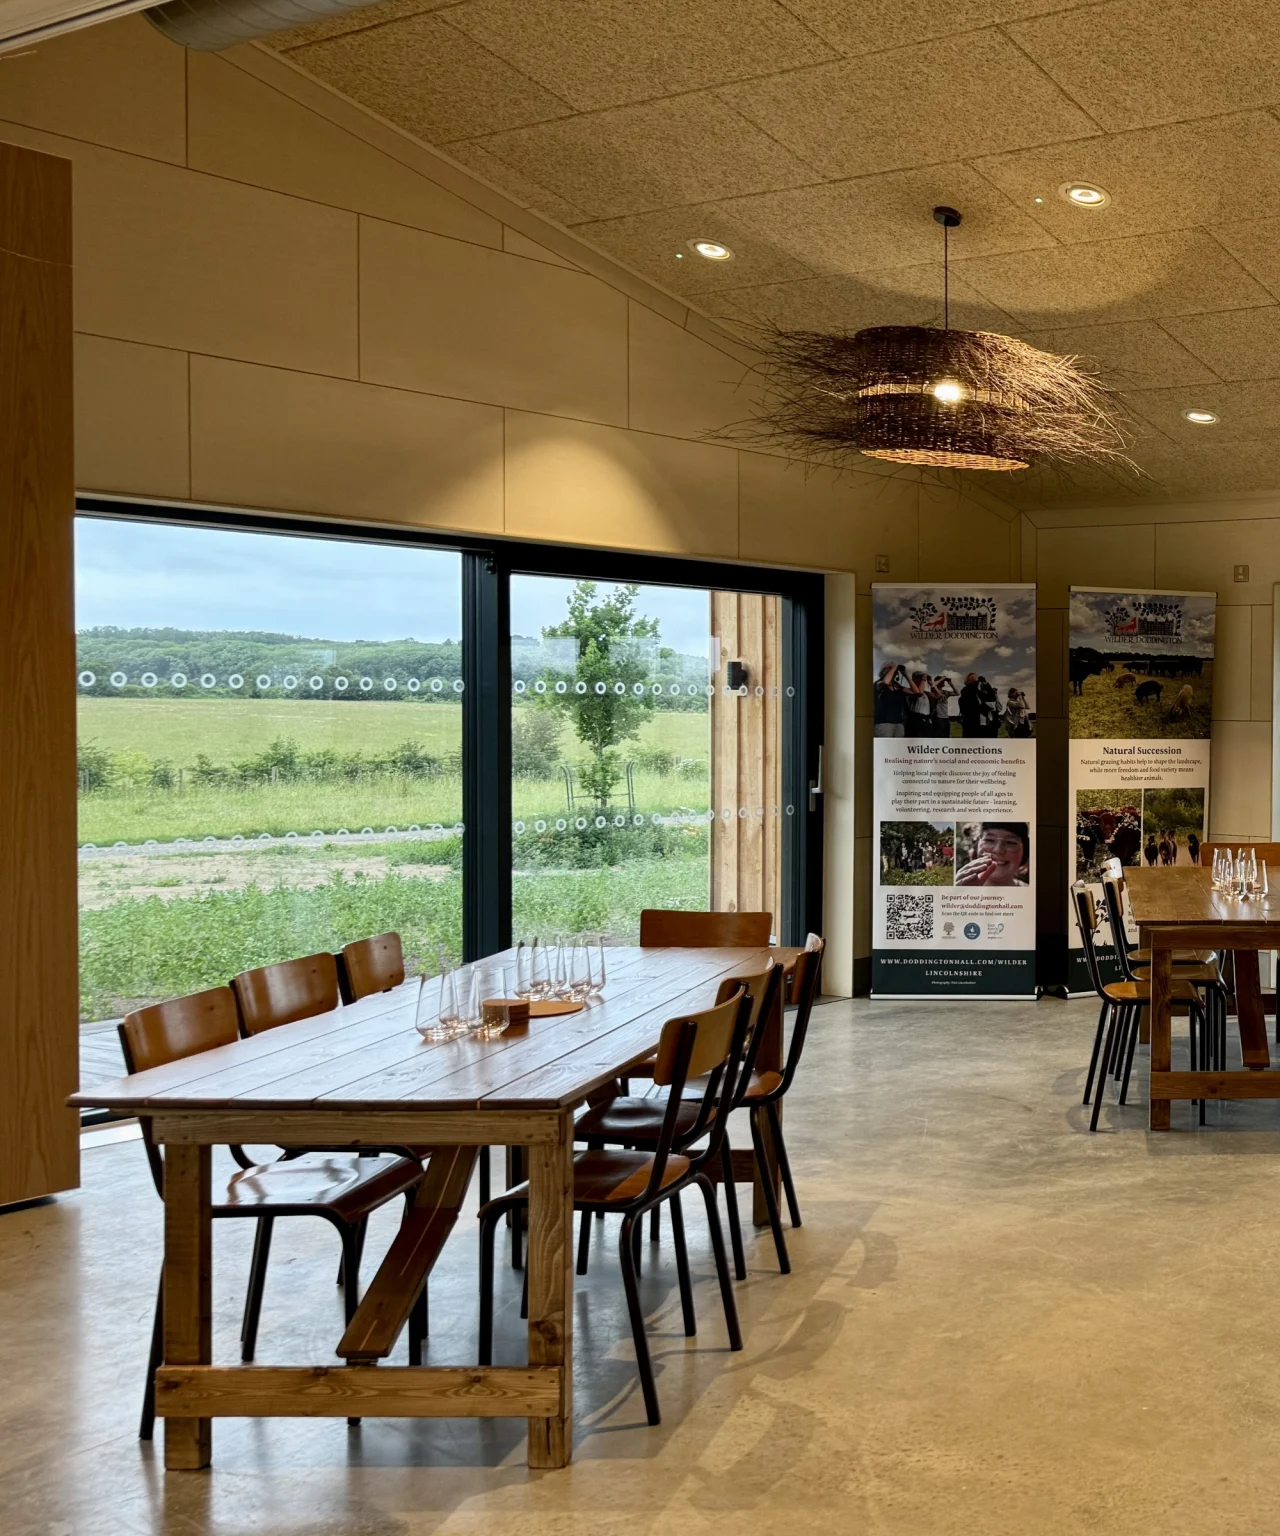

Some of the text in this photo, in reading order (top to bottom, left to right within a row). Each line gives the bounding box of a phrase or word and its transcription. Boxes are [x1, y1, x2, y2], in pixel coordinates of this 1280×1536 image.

[907, 746, 1002, 754] Wilder Connections
[1103, 746, 1182, 755] Natural Succession
